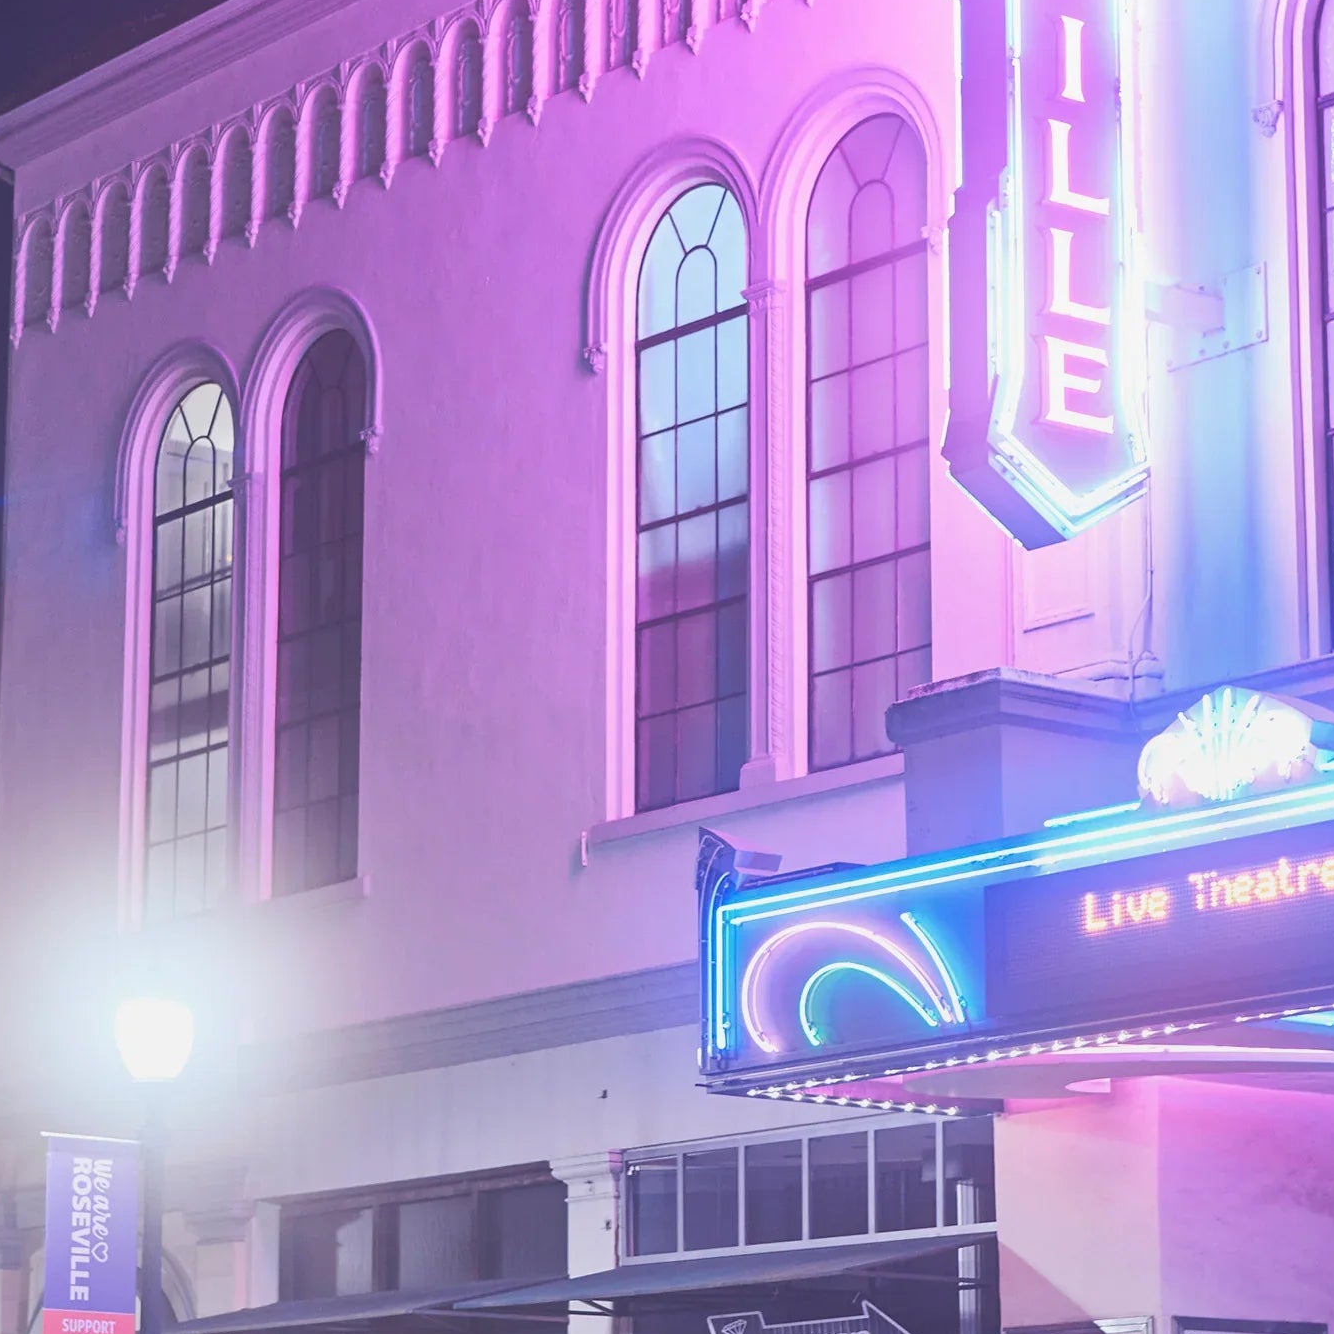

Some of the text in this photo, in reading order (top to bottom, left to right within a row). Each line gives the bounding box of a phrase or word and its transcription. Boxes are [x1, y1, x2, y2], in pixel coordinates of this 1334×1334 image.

[1083, 890, 1168, 933] Live
[69, 1157, 93, 1301] ROSEVILLE
[92, 1194, 111, 1240] are
[61, 1318, 116, 1334] SUPPORT
